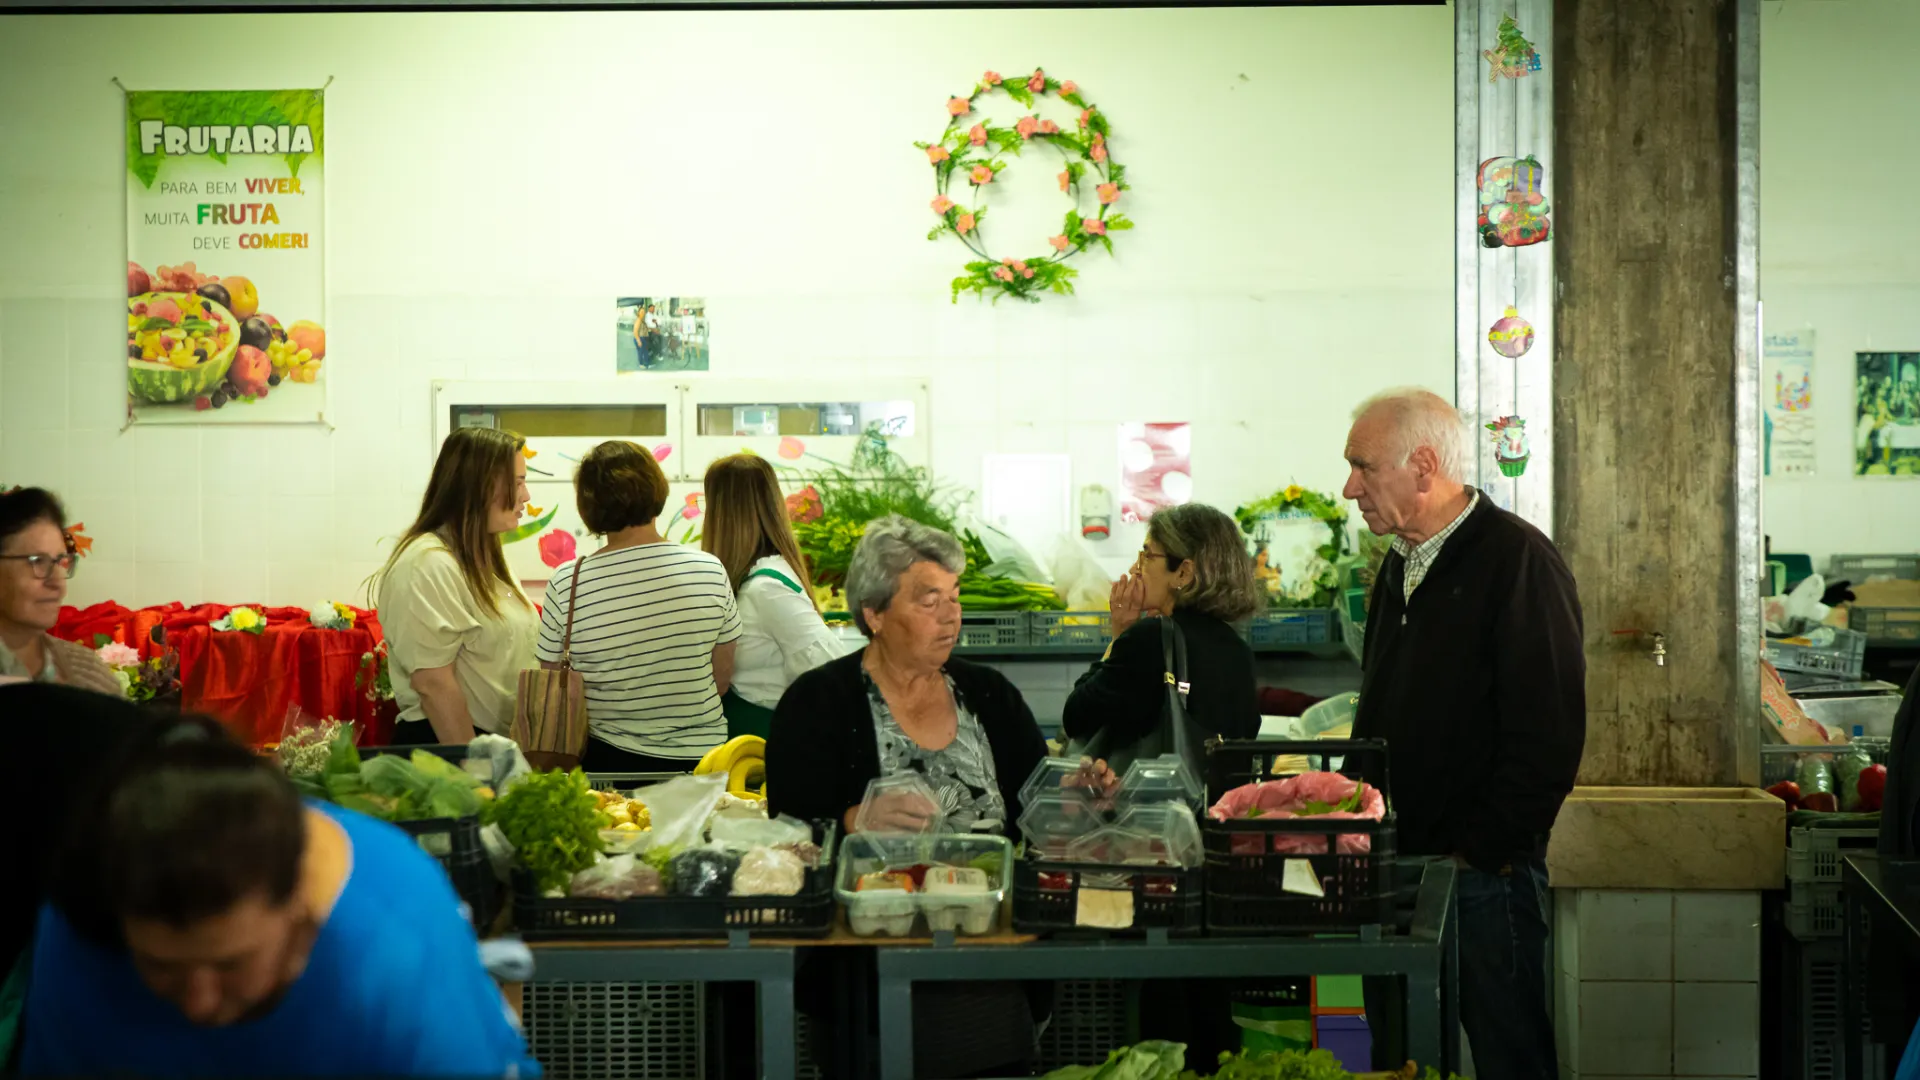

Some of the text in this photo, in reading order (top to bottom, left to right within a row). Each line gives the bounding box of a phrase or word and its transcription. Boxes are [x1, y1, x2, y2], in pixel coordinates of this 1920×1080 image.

[139, 119, 314, 155] FRUTARIA
[160, 178, 305, 196] PARA BEM VIVER,
[144, 203, 280, 225] MUITA FRUTA
[193, 233, 309, 249] DEVE COMER!
